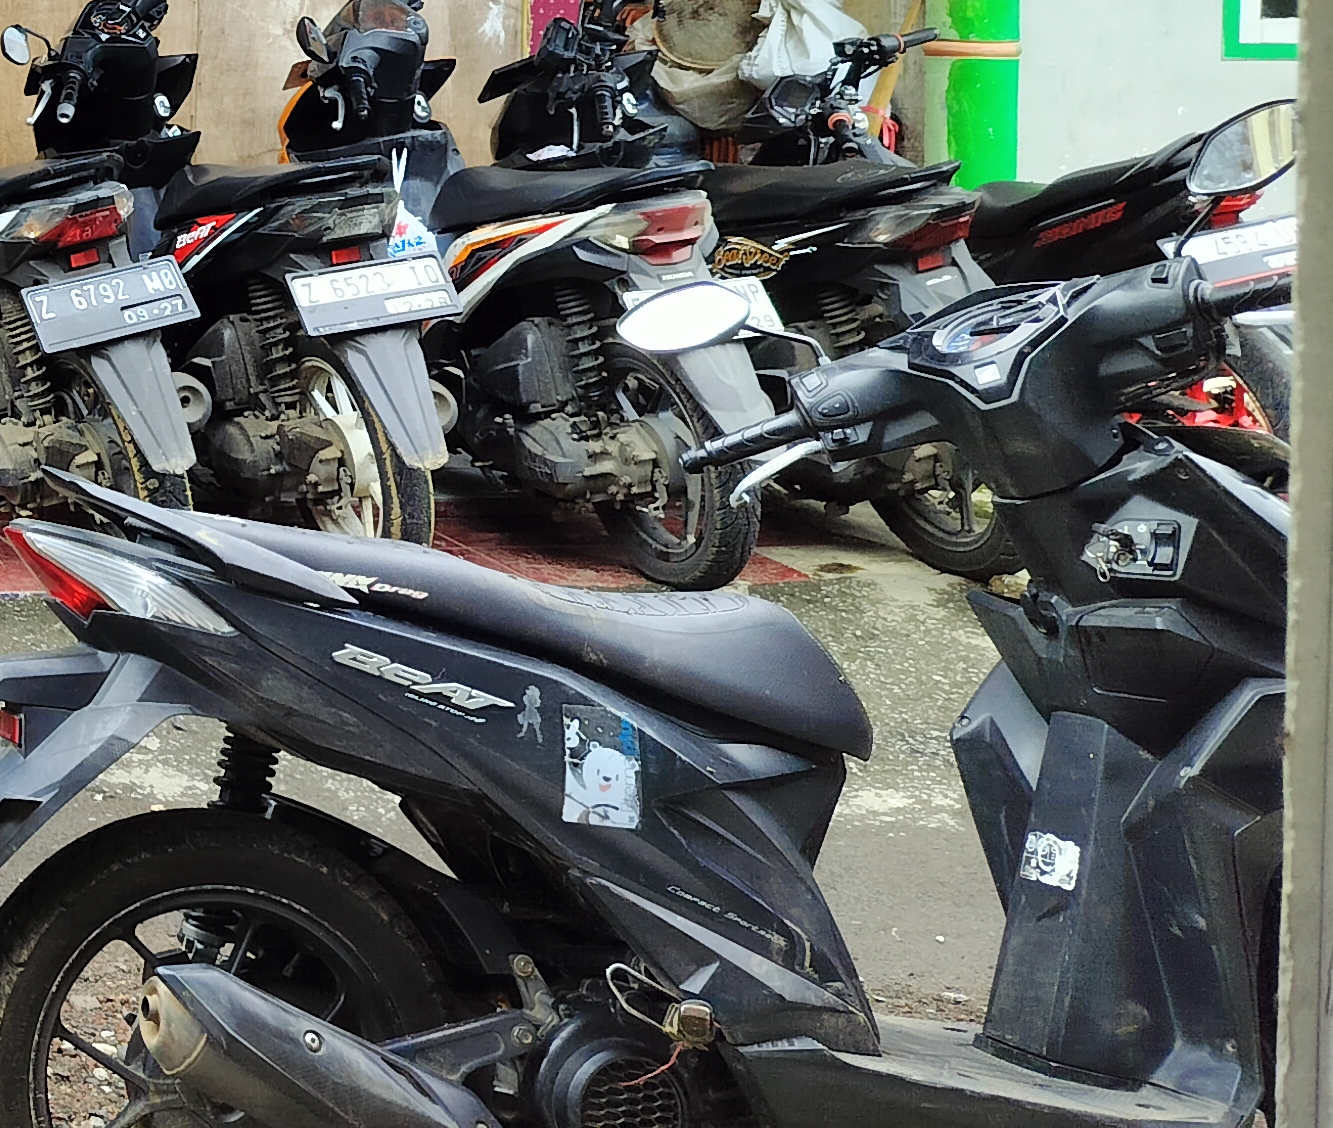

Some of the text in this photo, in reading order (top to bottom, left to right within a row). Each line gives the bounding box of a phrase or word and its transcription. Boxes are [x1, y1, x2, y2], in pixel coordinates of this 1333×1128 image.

[34, 295, 56, 320] Z
[70, 278, 130, 310] 6792
[300, 282, 320, 304] Z
[665, 884, 722, 914] Compact
